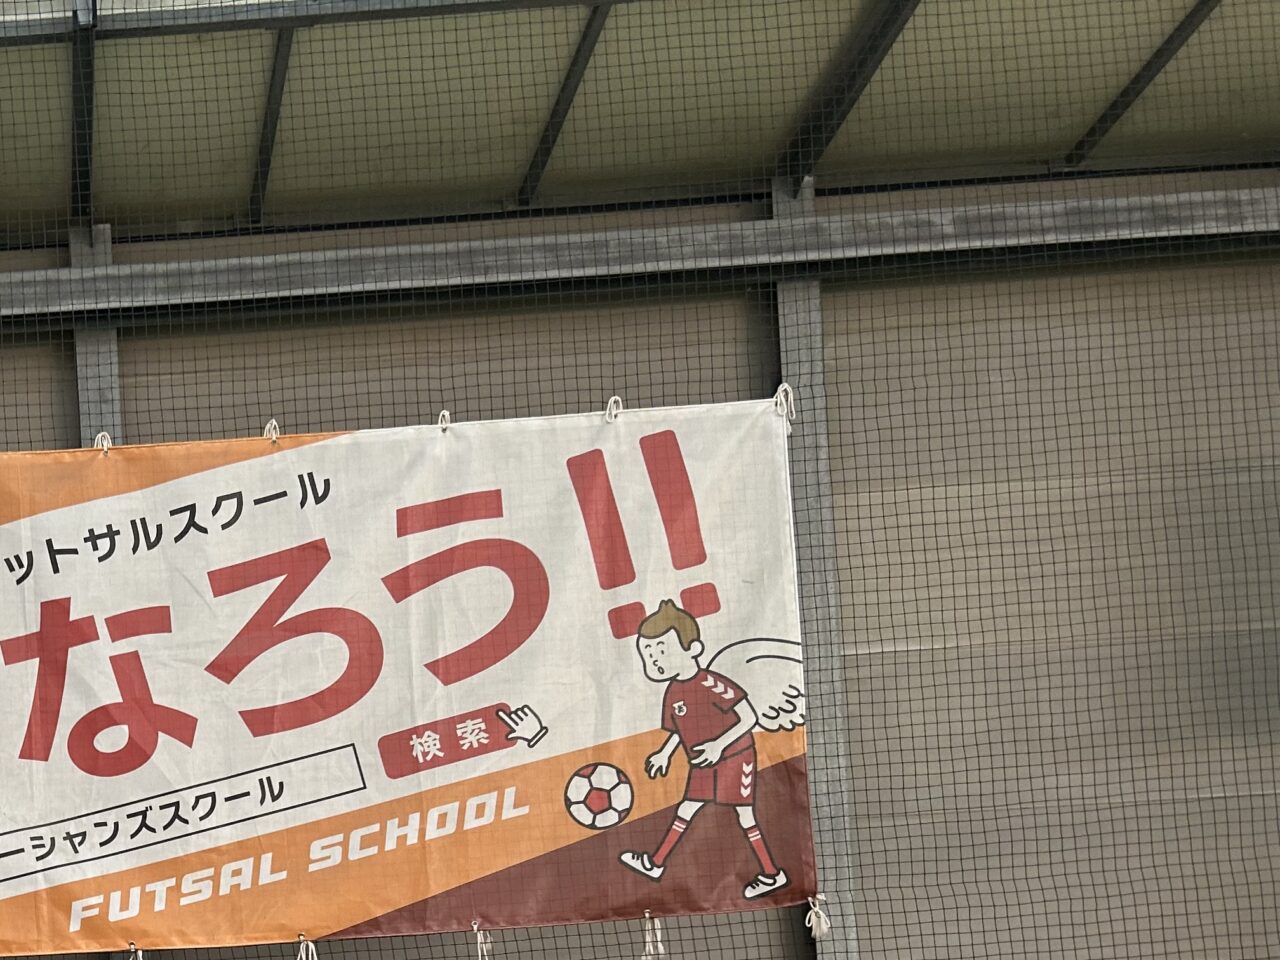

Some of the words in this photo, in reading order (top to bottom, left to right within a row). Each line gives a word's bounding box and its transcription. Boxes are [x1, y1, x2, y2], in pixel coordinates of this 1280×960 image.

[408, 717, 491, 764] 検索
[68, 851, 288, 933] FUTSAL
[307, 786, 531, 874] SCHOOL
